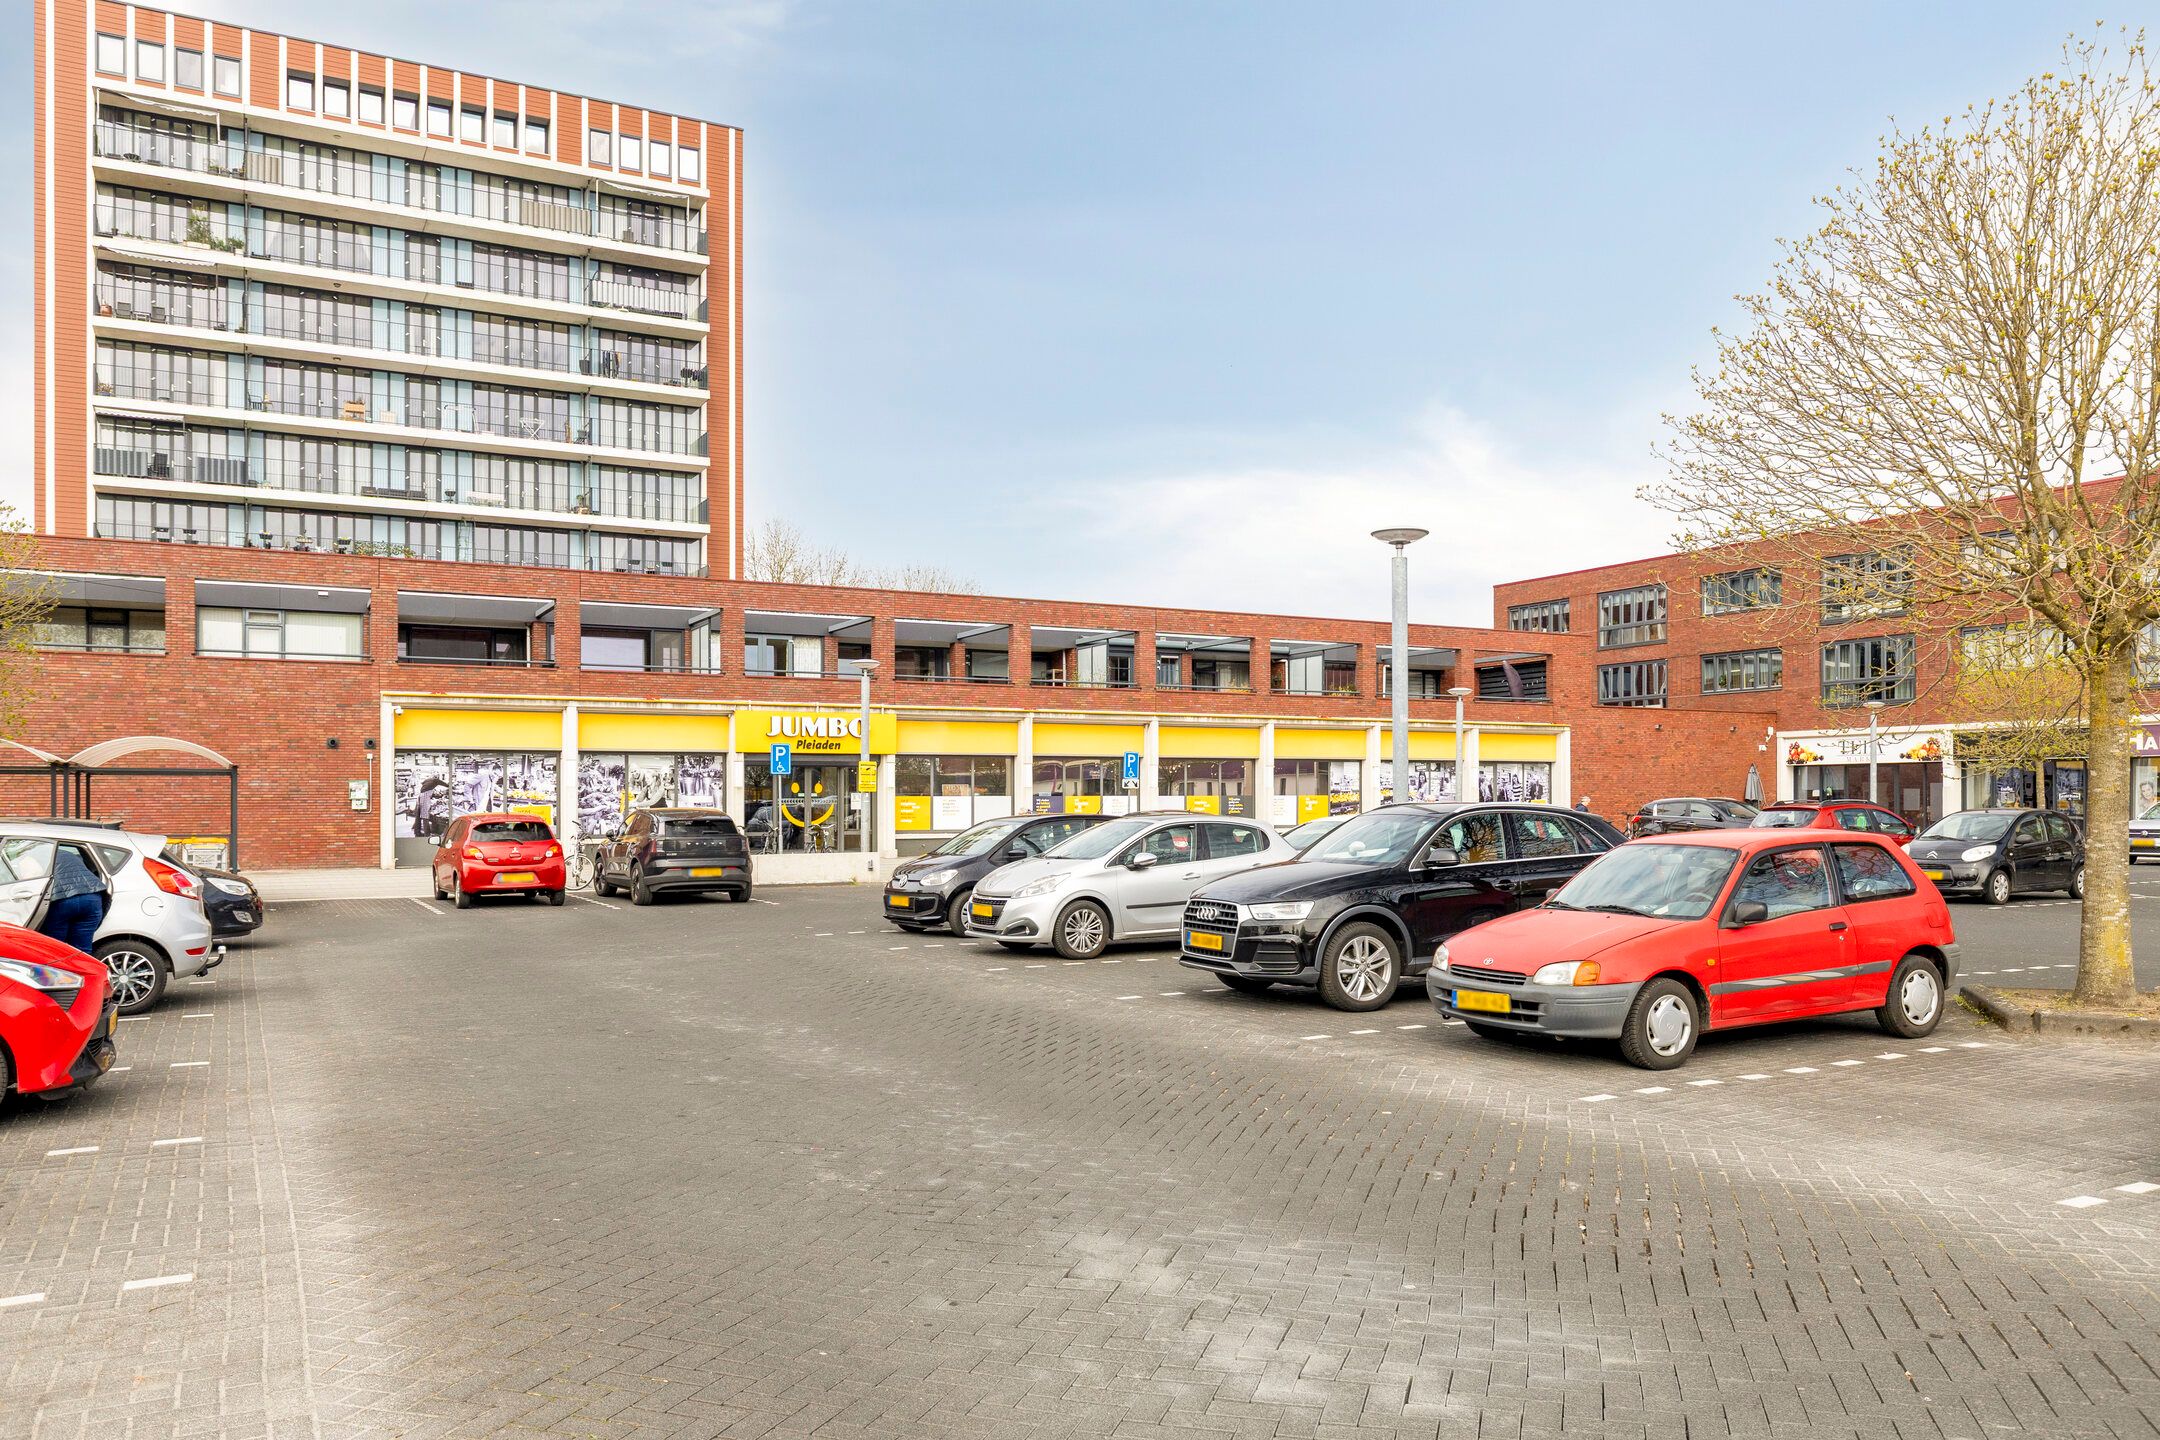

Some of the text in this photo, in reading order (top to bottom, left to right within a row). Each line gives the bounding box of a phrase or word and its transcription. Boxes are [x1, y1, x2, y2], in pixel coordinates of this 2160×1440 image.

[766, 715, 863, 738] JUMBO
[796, 739, 841, 750] Pleiaden
[775, 746, 786, 762] P
[1127, 754, 1136, 768] P
